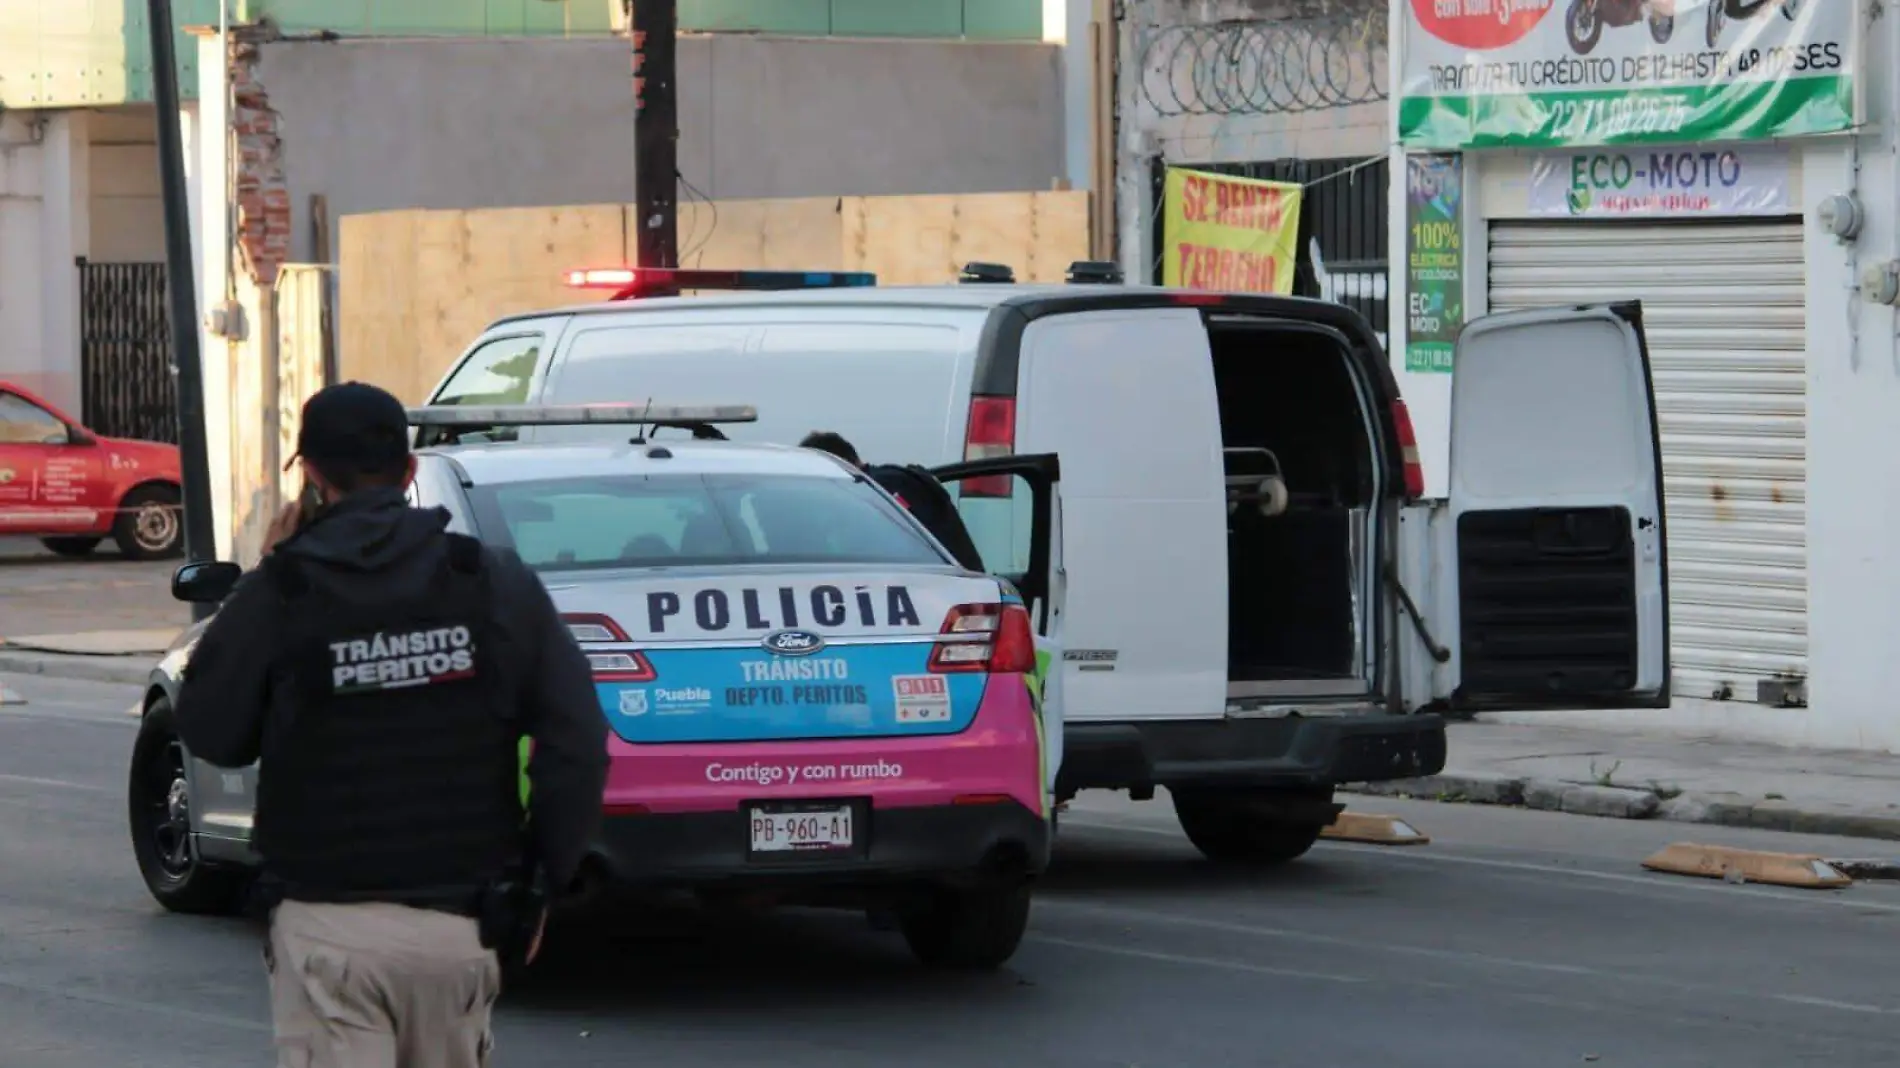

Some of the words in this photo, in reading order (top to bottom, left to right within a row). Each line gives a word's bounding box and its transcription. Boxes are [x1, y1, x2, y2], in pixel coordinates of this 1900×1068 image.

[1508, 61, 1528, 87] TU
[1531, 54, 1616, 86] CRÉDITO
[1621, 54, 1648, 82] DE
[1652, 55, 1666, 79] 12
[1766, 42, 1842, 72] MSES
[1550, 99, 1577, 138] 22
[1571, 150, 1741, 190] ECO-MOTO
[1183, 175, 1209, 222] SE
[1215, 180, 1282, 234] RENTA
[1412, 221, 1459, 249] 100%
[1178, 242, 1277, 293] TERRENO
[1411, 316, 1440, 333] MOTO
[646, 584, 922, 633] POLICÍA
[329, 625, 471, 664] TRÁNSITO
[777, 632, 811, 648] Ford
[332, 649, 474, 688] PERITOS
[740, 655, 848, 682] TRÁNSITO
[655, 687, 712, 702] Puebla
[725, 685, 790, 707] DEPTO.
[793, 684, 867, 705] PERITOS
[705, 762, 783, 785] Contigo
[787, 765, 799, 785] y
[803, 764, 835, 779] con
[841, 759, 902, 778] rumbo
[753, 818, 849, 842] PB-960-A1
